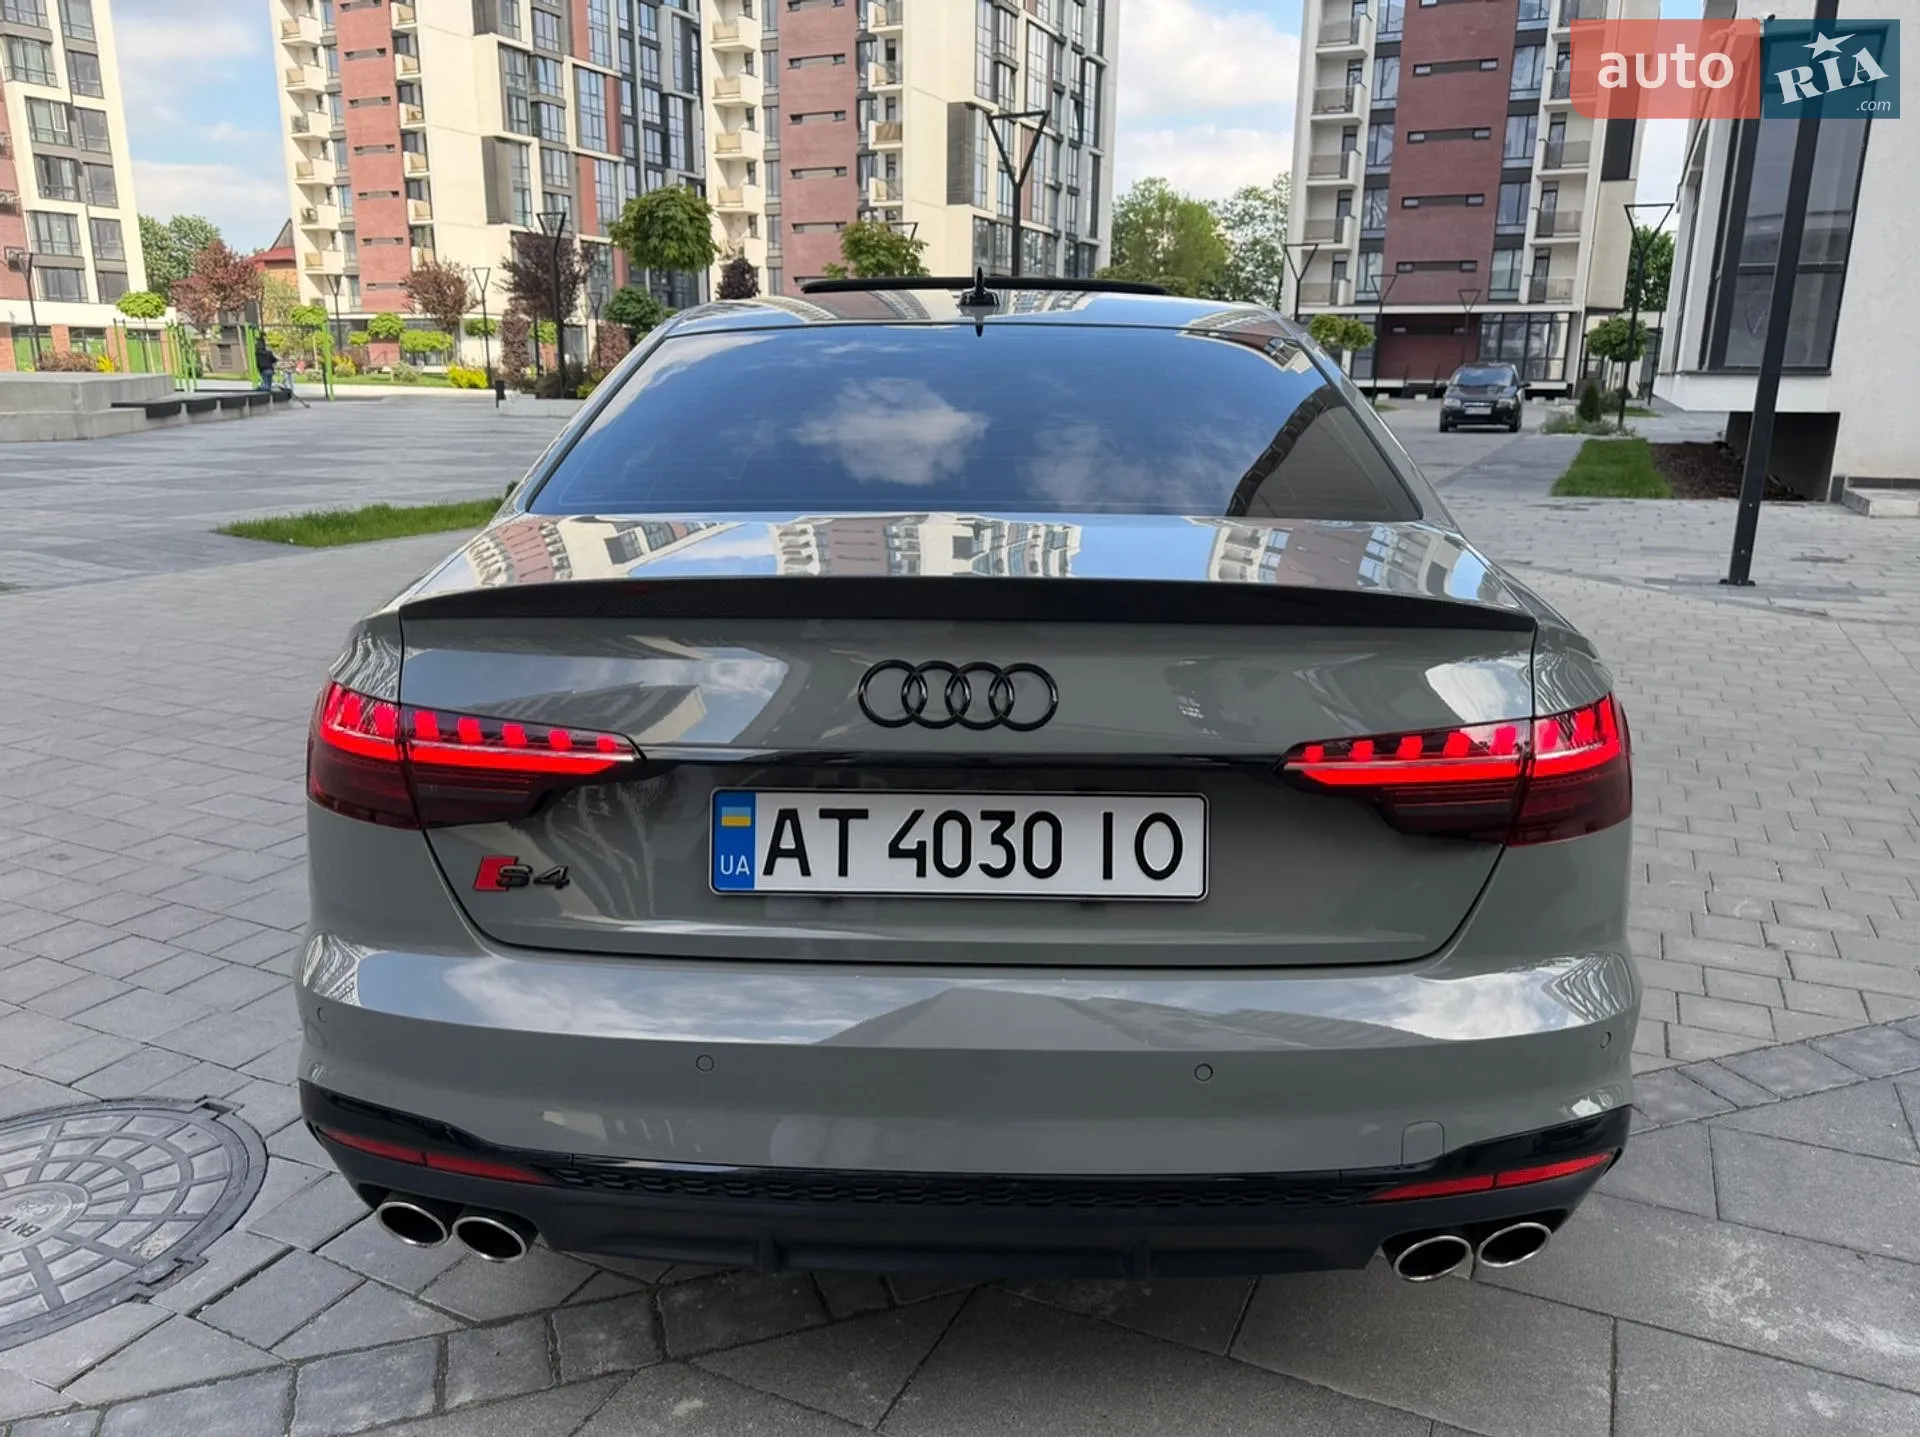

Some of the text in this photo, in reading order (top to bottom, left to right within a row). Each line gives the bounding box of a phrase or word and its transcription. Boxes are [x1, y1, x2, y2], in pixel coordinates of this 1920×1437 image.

[762, 808, 1184, 881] AT 4030 IO
[495, 863, 570, 890] S4
[720, 854, 751, 876] UA
